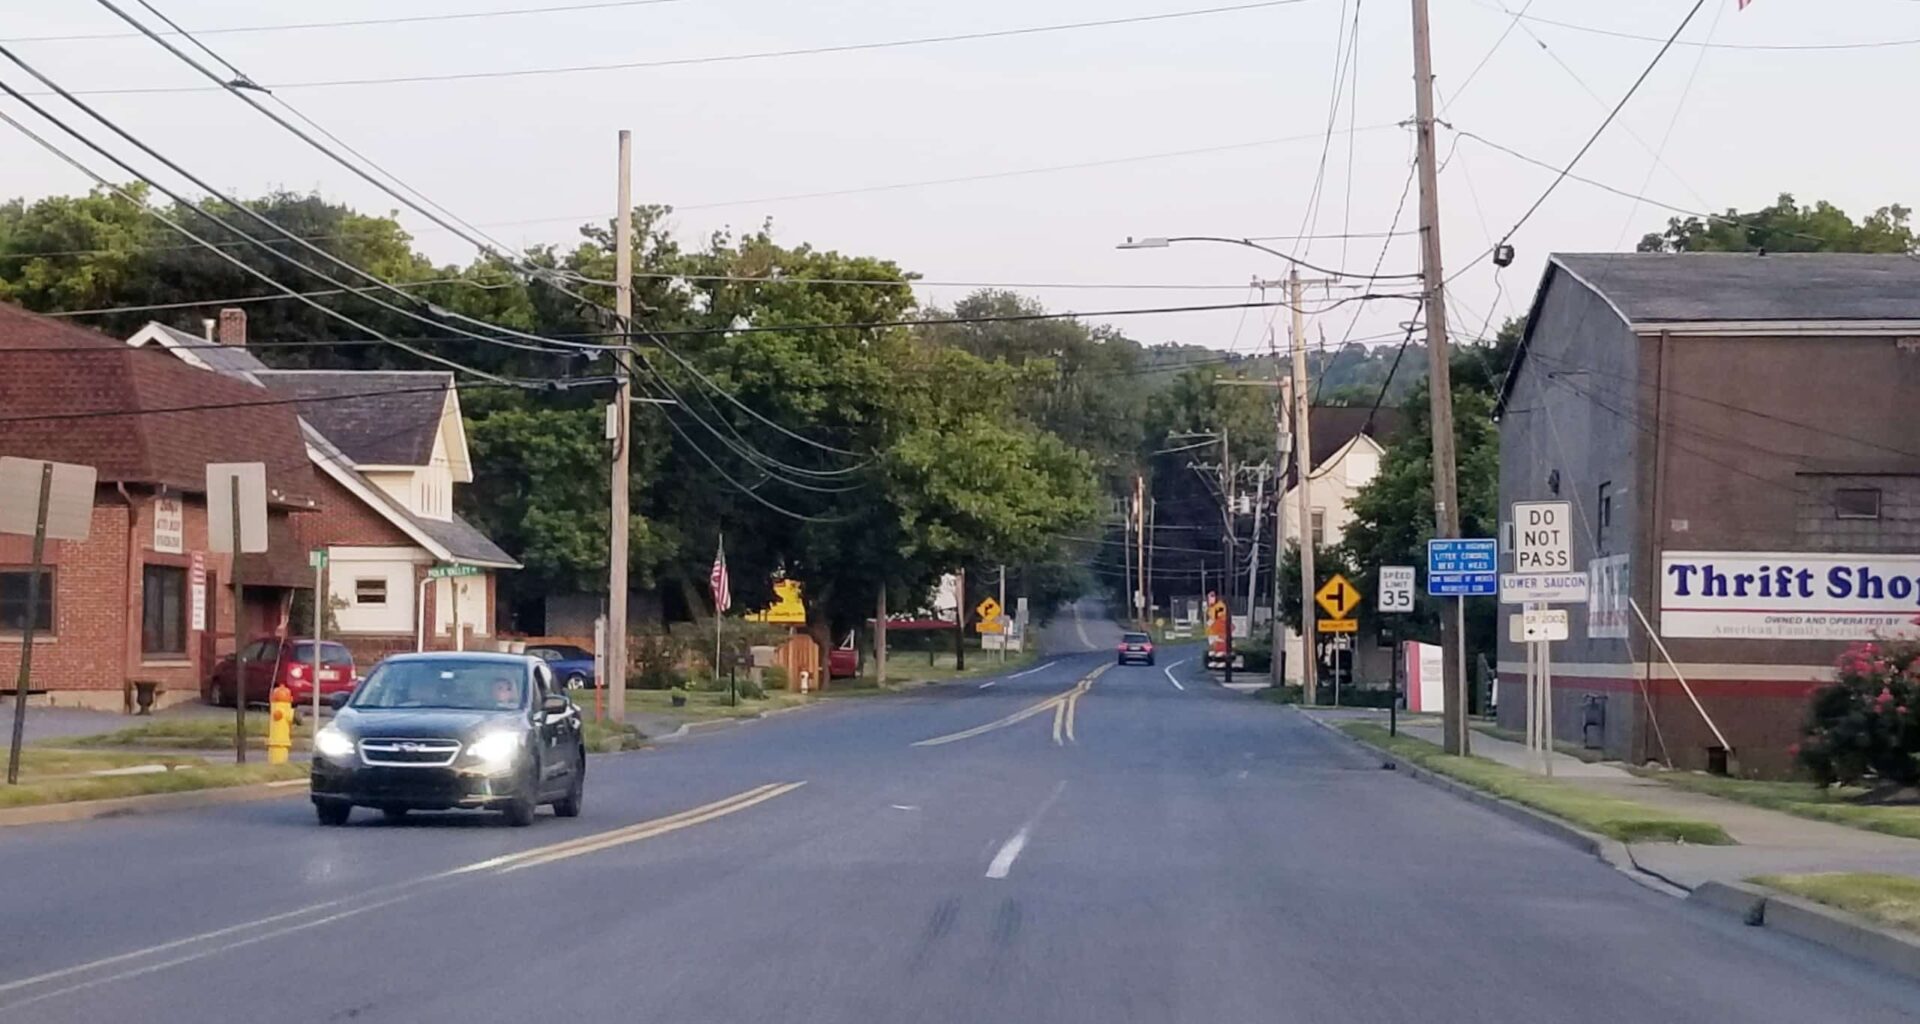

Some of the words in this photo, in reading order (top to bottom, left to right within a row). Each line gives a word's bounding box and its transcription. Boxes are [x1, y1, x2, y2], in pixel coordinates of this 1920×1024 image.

[1530, 510, 1554, 525] DO
[1525, 531, 1559, 546] NOT
[1520, 551, 1567, 567] PASS
[1503, 578, 1537, 588] LOWER
[1544, 577, 1585, 588] SAUCON
[1667, 564, 1814, 598] Thrift
[1826, 566, 1920, 606] Sho
[1383, 590, 1410, 606] 35
[1764, 616, 1803, 624] OWNED
[1805, 616, 1826, 624] AND
[1829, 617, 1883, 625] OPERATED
[1885, 617, 1900, 625] BY
[1712, 625, 1772, 634] American
[1777, 625, 1820, 636] Family
